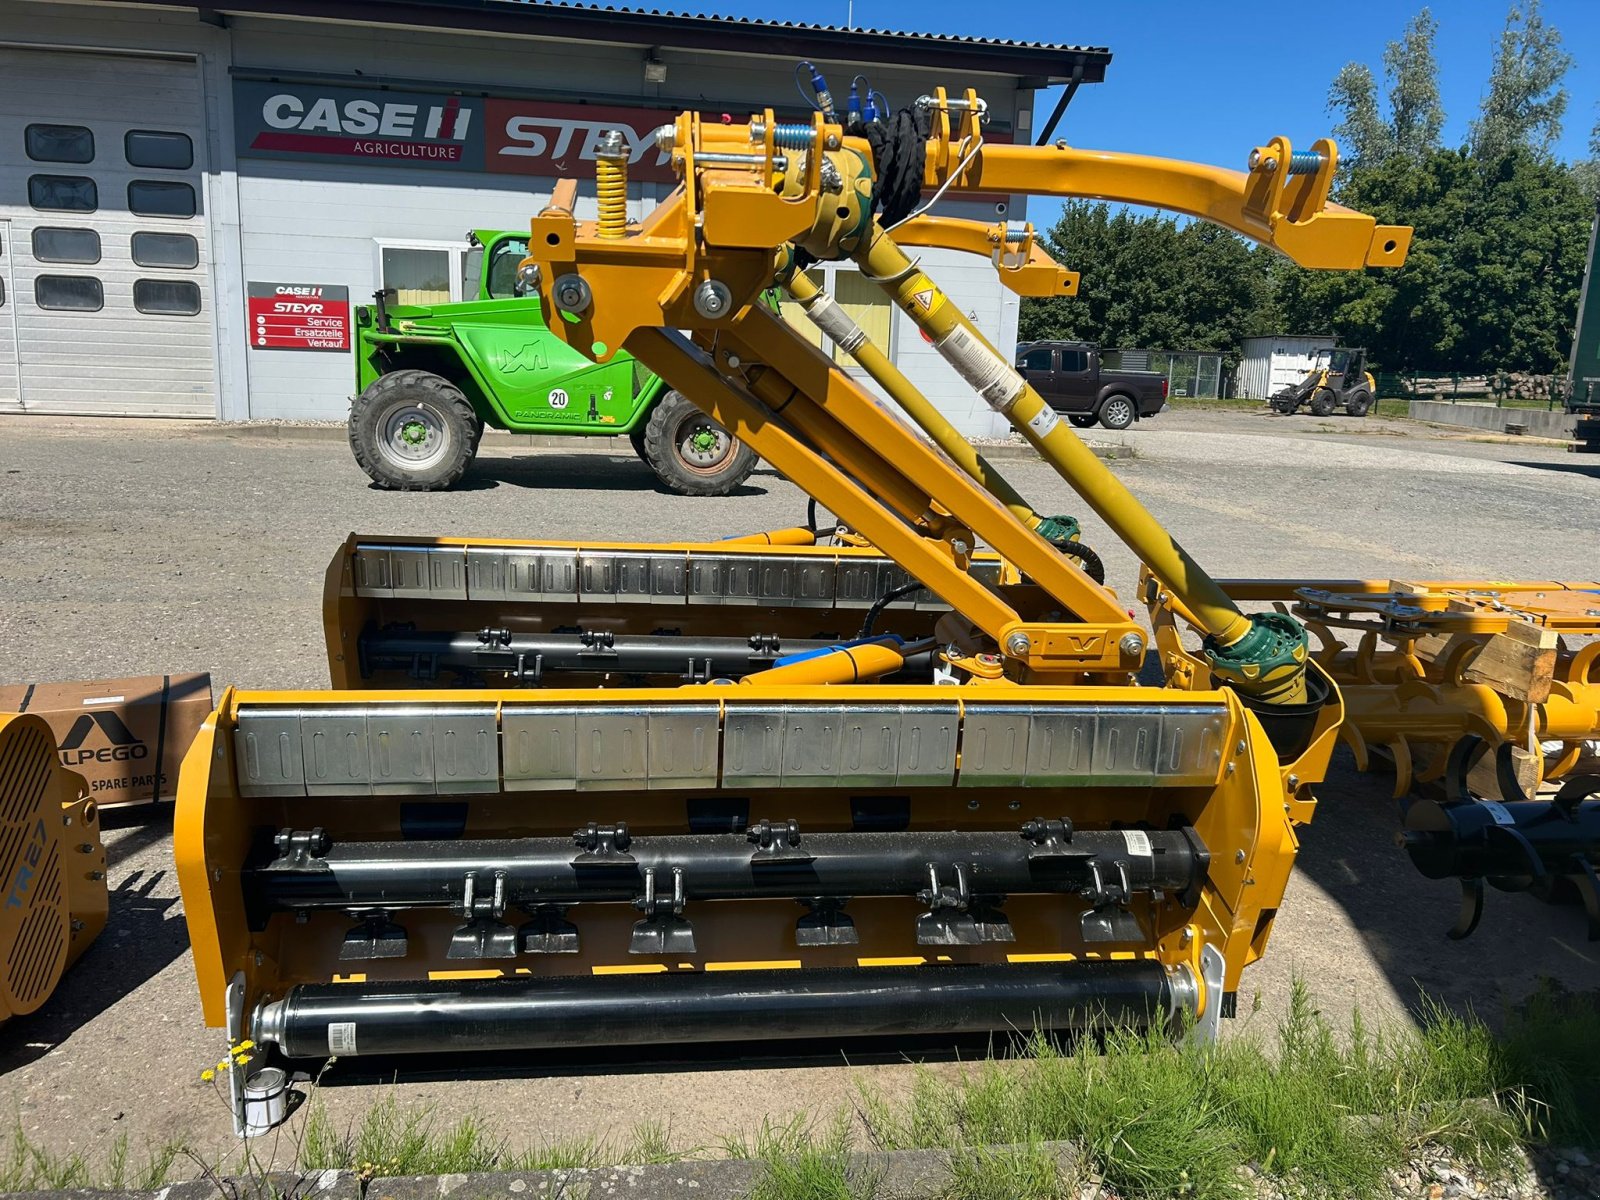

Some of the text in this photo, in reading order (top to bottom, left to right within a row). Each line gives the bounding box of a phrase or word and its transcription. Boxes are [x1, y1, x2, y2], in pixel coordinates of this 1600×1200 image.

[262, 94, 418, 137] CASE
[353, 141, 456, 159] AGRICULTURE
[275, 286, 311, 296] CASE
[273, 302, 324, 314] STEYR
[307, 317, 343, 327] Service
[295, 328, 343, 338] Ersatzteile
[307, 339, 344, 348] Verkauf
[551, 392, 566, 406] 20
[515, 411, 582, 421] PANORAMIC
[57, 744, 148, 766] LPEGO
[91, 773, 168, 792] SPARE PARS
